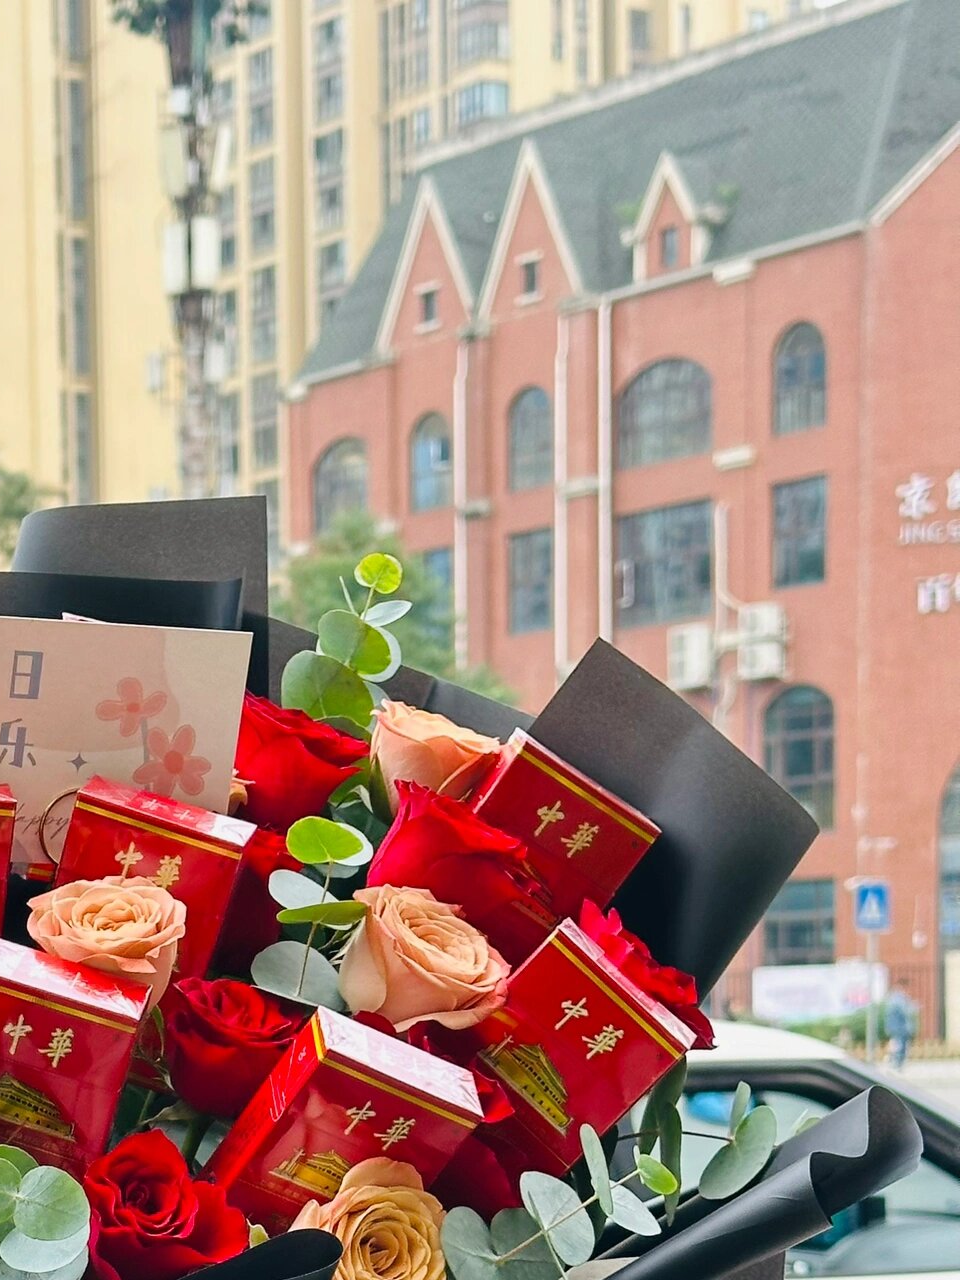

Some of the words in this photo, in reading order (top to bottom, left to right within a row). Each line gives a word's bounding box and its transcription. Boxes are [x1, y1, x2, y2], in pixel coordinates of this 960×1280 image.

[534, 800, 601, 859] 中華
[115, 841, 182, 889] 中華
[3, 1013, 75, 1068] 中華
[554, 996, 625, 1060] 中華
[344, 1099, 416, 1151] 中華
